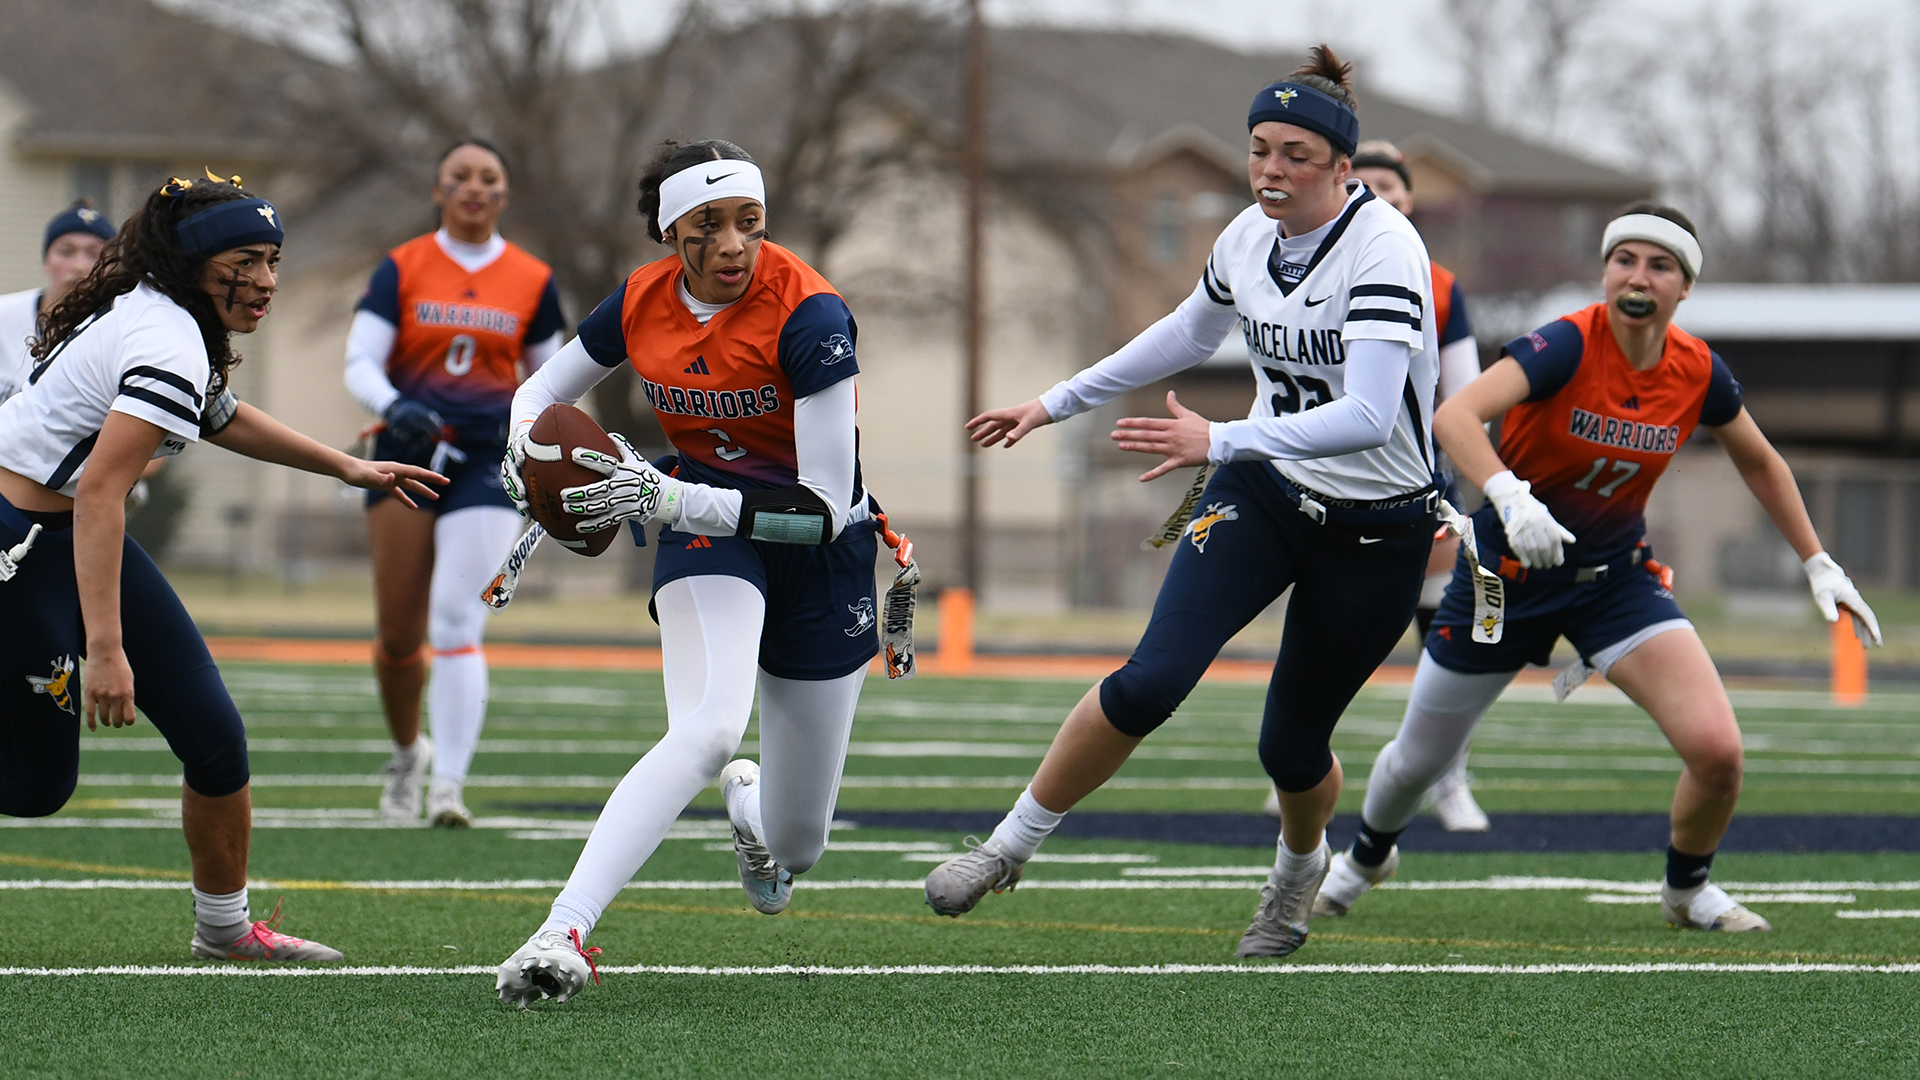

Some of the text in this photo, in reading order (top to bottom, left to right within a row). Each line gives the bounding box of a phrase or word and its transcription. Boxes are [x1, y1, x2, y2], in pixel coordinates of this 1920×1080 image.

[414, 300, 519, 338] WARRIORS
[1238, 312, 1346, 365] RACELAND
[444, 333, 478, 377] 0
[640, 376, 780, 419] WARRIORS
[1568, 406, 1680, 454] WARRIORS
[1573, 456, 1642, 499] 17
[1320, 494, 1356, 509] PRO
